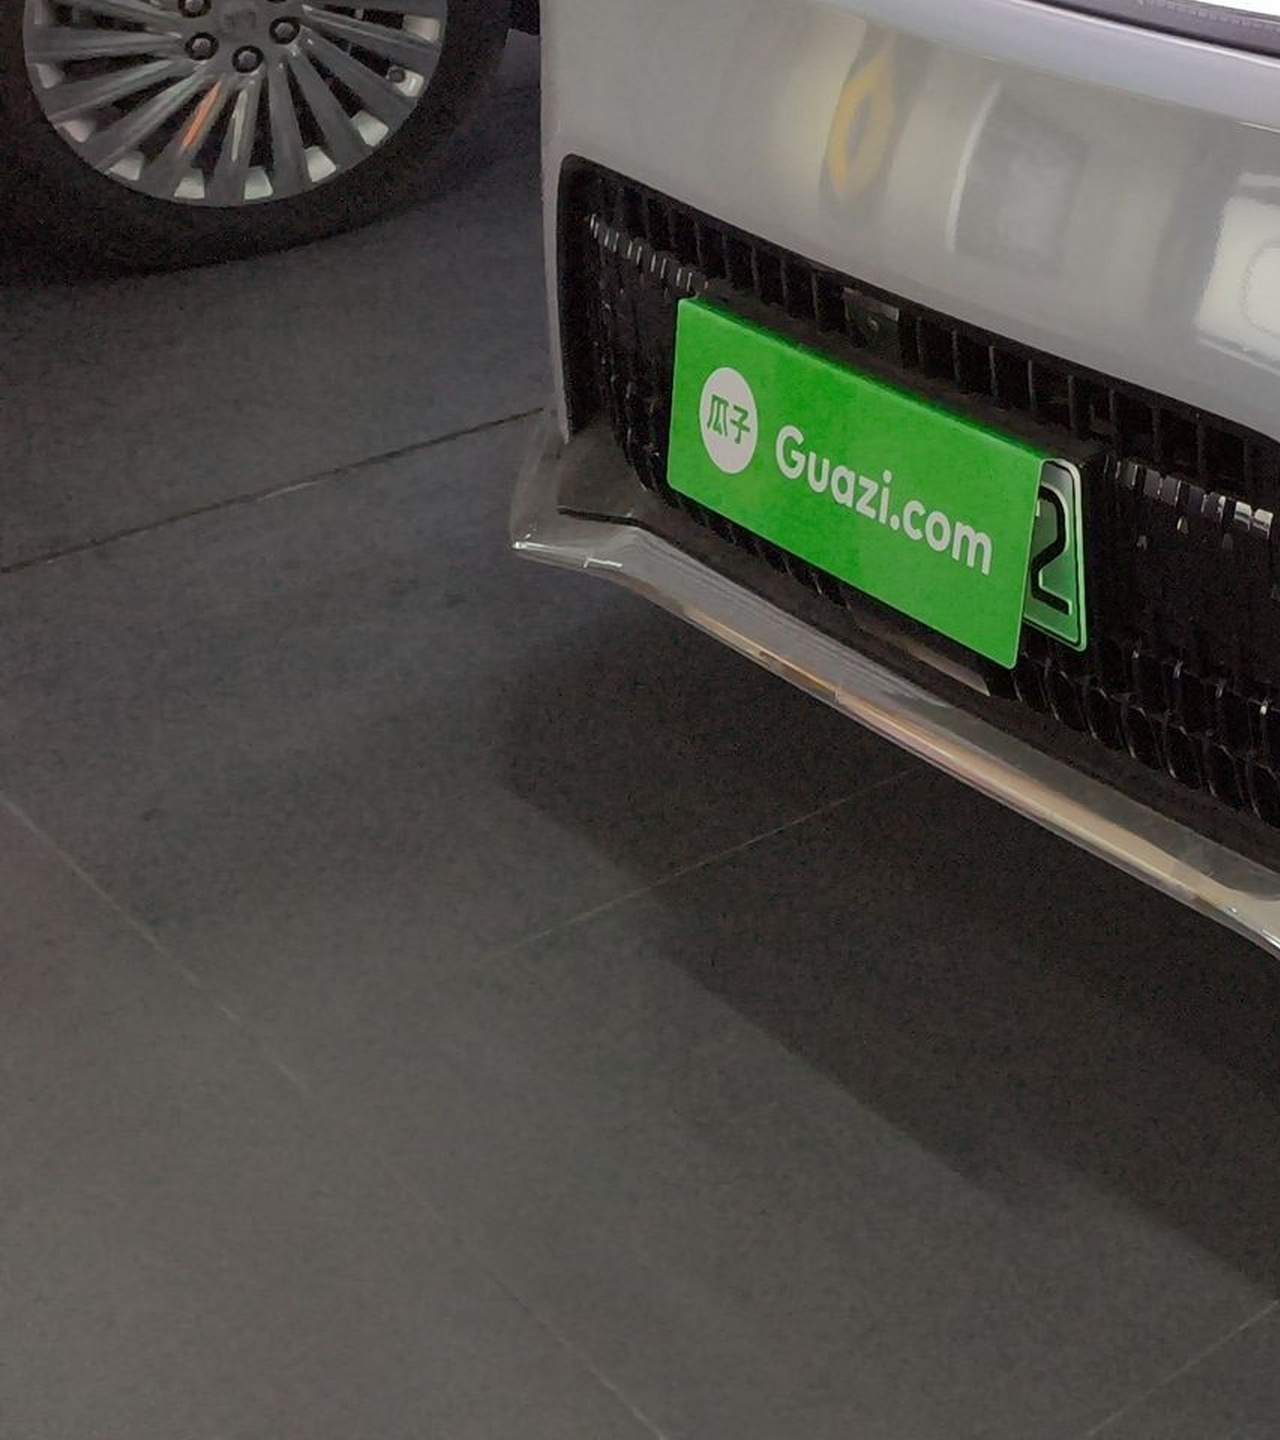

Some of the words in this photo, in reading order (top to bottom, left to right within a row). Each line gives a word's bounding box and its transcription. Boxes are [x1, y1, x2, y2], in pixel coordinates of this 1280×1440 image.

[706, 394, 752, 444] 瓜子
[775, 425, 993, 576] Guazi.com
[1030, 481, 1073, 616] 2
